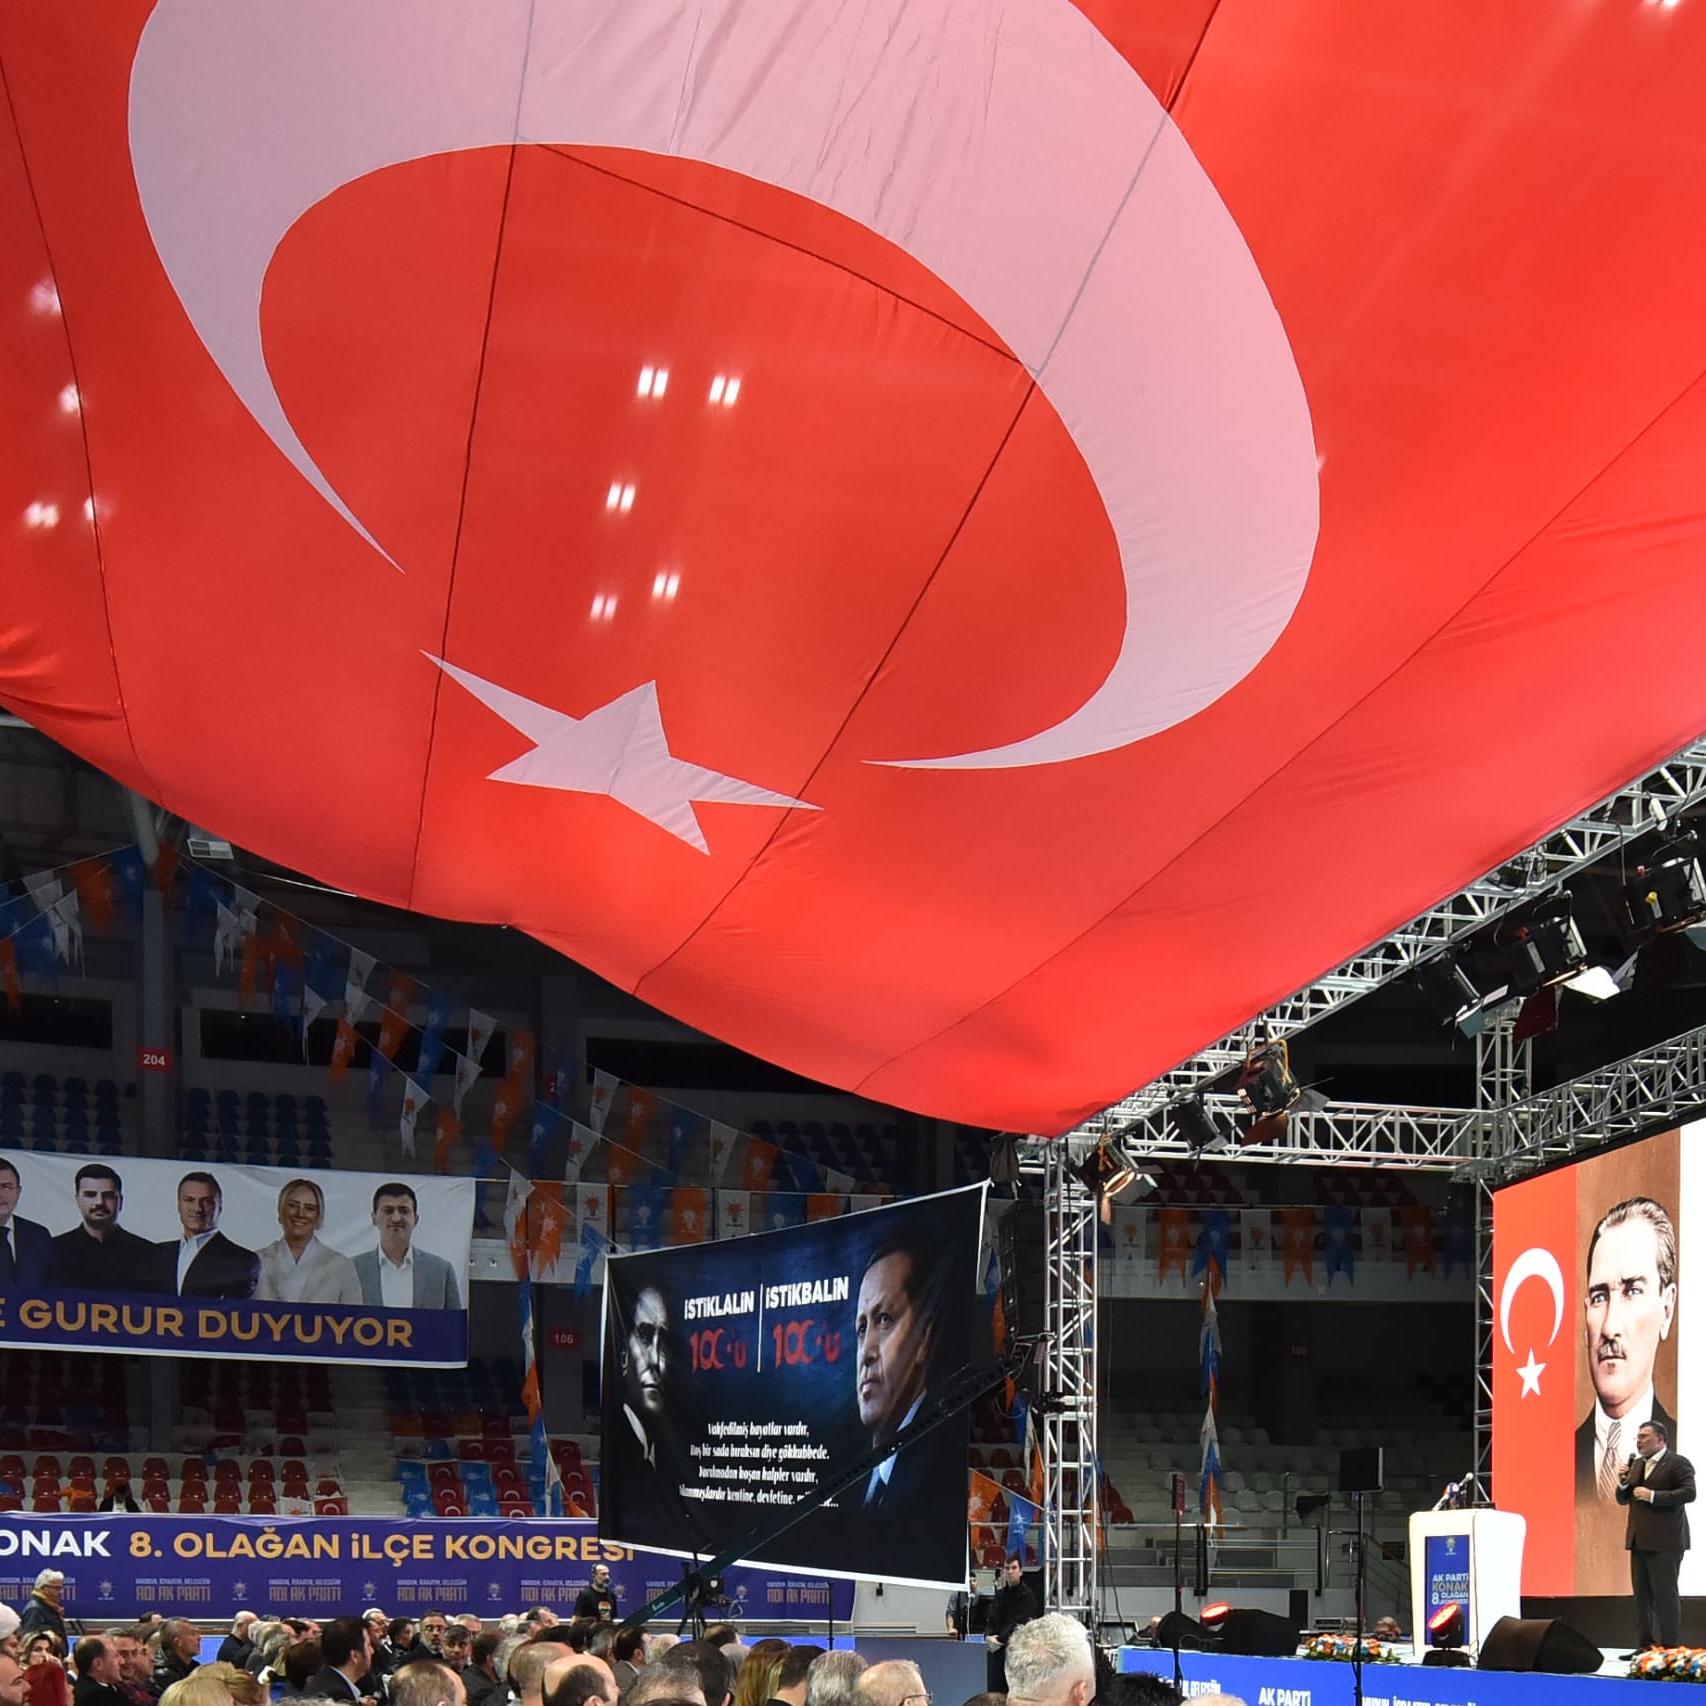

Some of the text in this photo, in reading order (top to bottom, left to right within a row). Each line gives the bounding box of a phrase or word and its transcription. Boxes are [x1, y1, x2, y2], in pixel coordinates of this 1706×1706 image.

[143, 1053, 165, 1066] 204
[19, 1298, 185, 1338] GURUR
[197, 1309, 414, 1349] DUYUYOR
[129, 1531, 162, 1558] 8.
[173, 1528, 339, 1559] OLAĞAN
[1432, 1582, 1468, 1592] KONAK
[1258, 1687, 1276, 1706] AK
